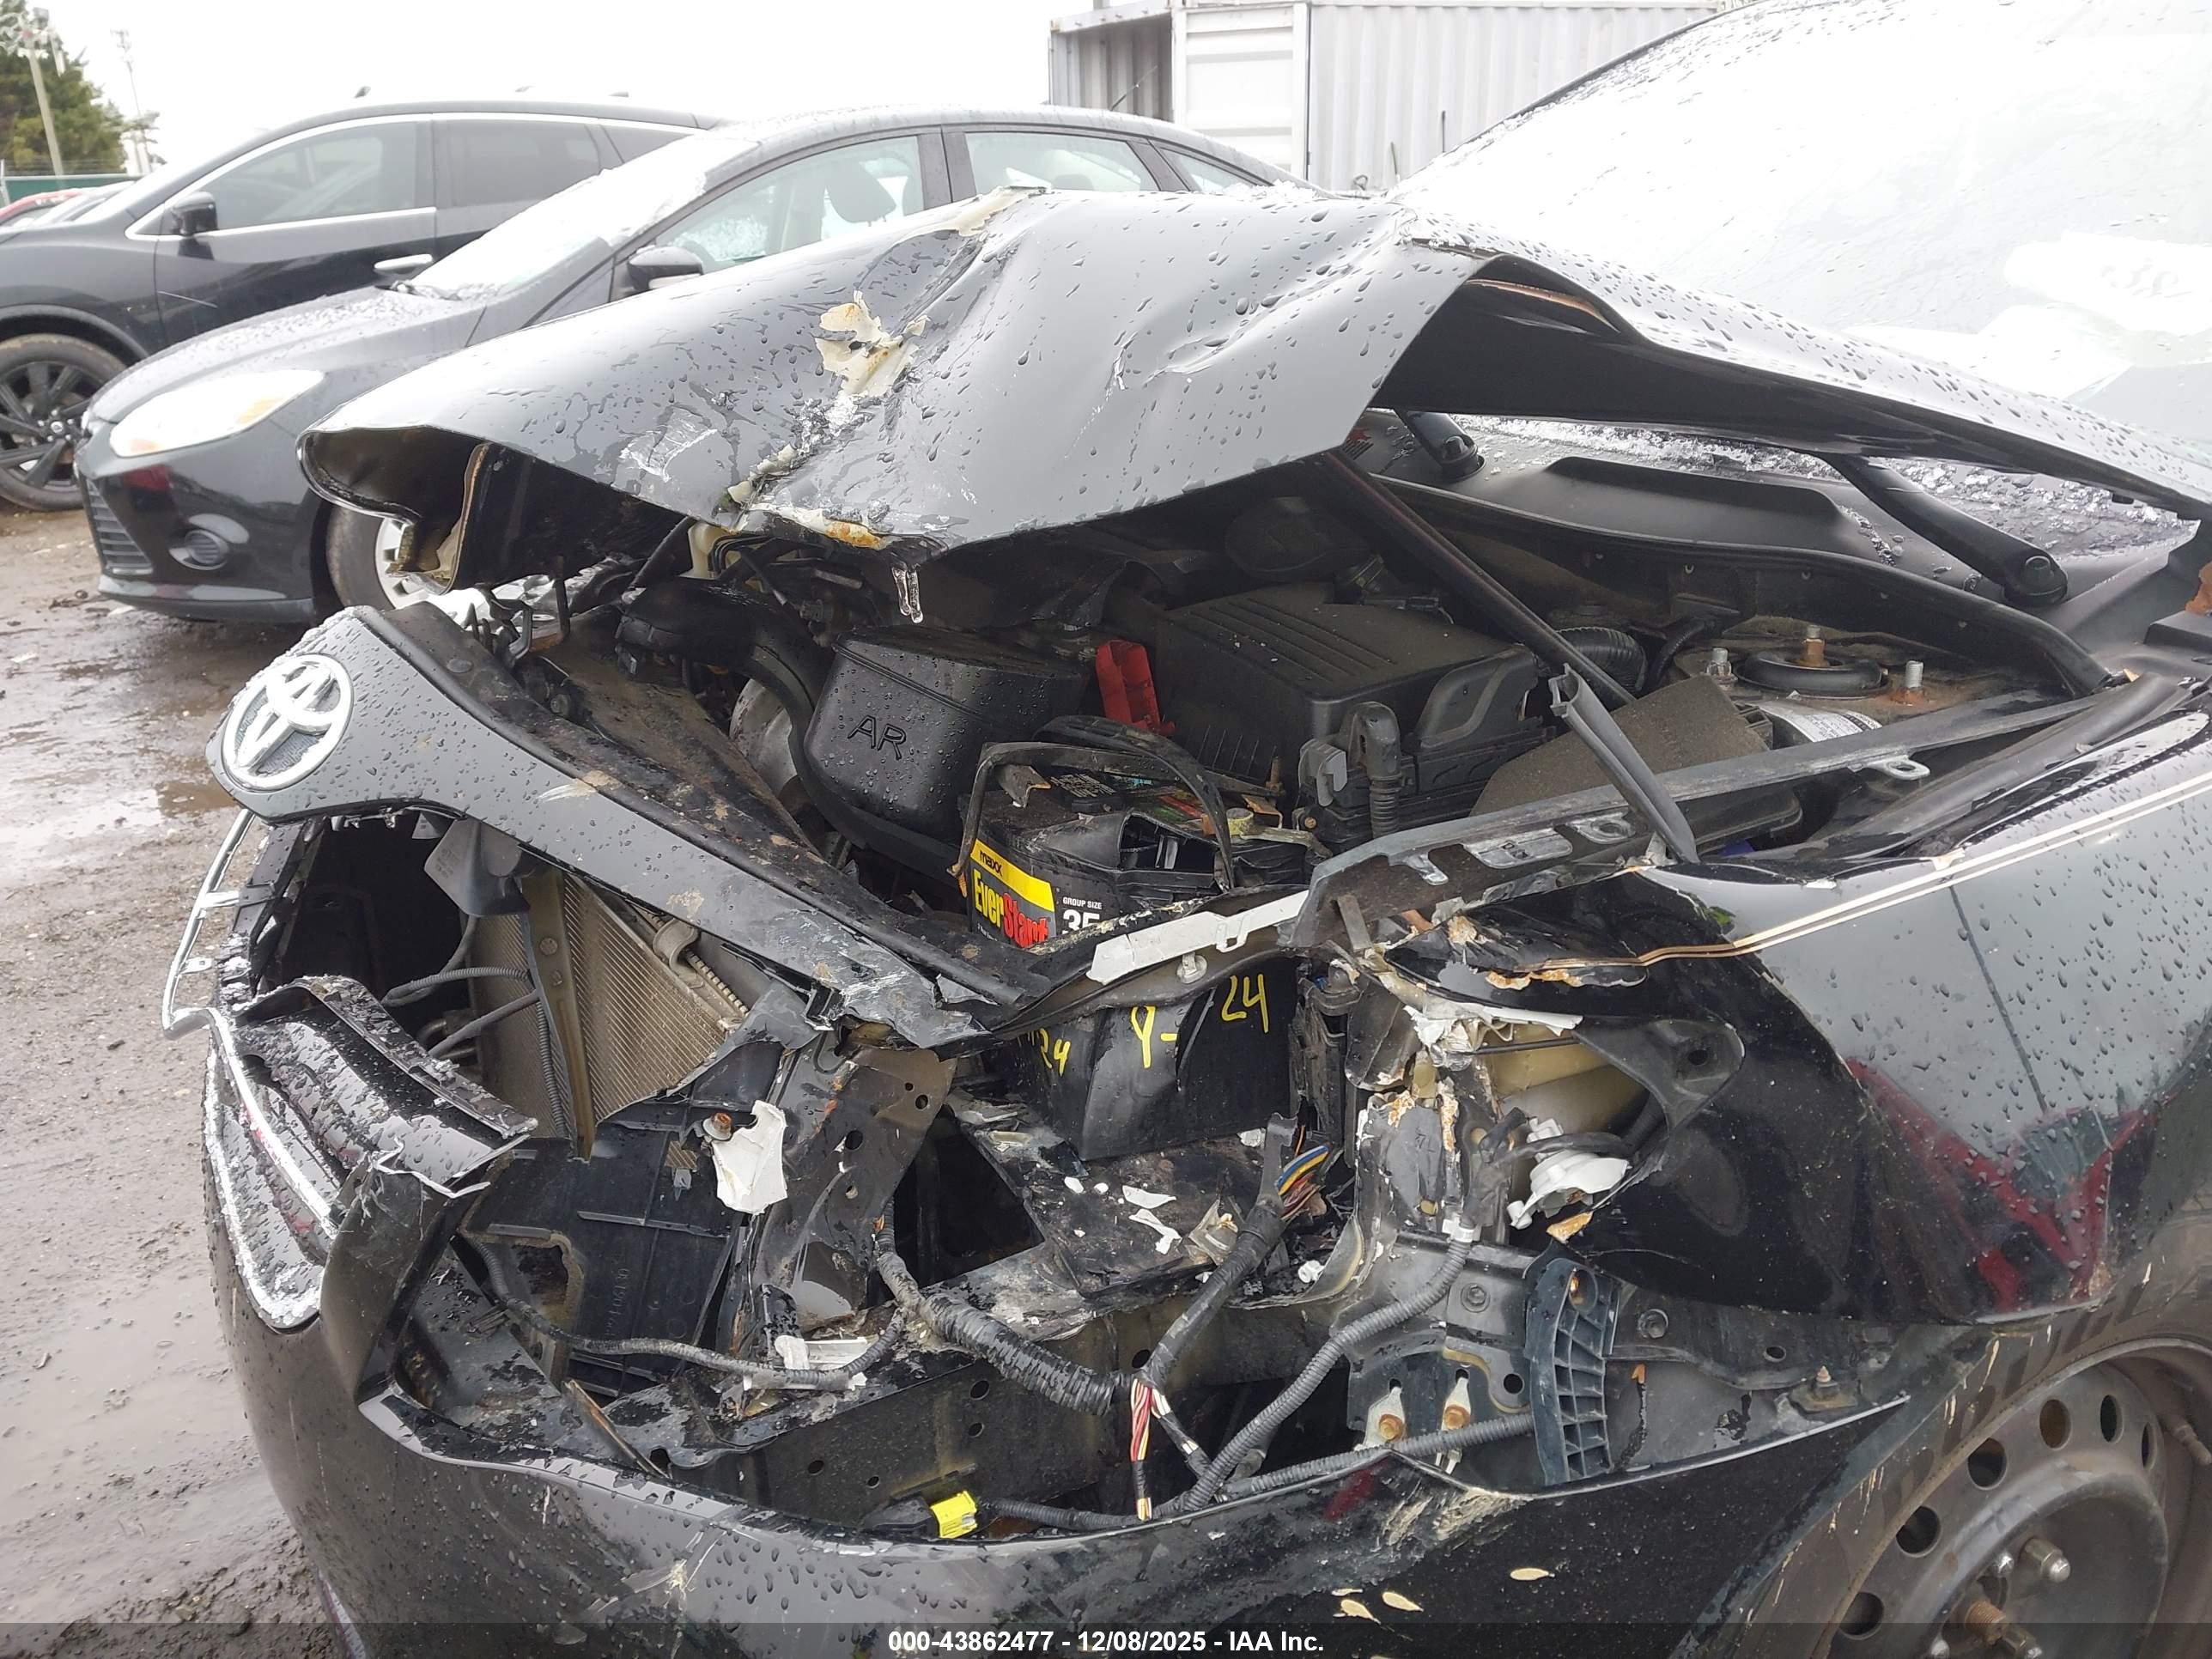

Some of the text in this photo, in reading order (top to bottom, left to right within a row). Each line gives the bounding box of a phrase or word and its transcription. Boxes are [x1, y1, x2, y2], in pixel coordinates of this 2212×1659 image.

[847, 714, 907, 761] AR
[979, 849, 1003, 878] maxx
[1062, 896, 1103, 910] GROUP SIZE
